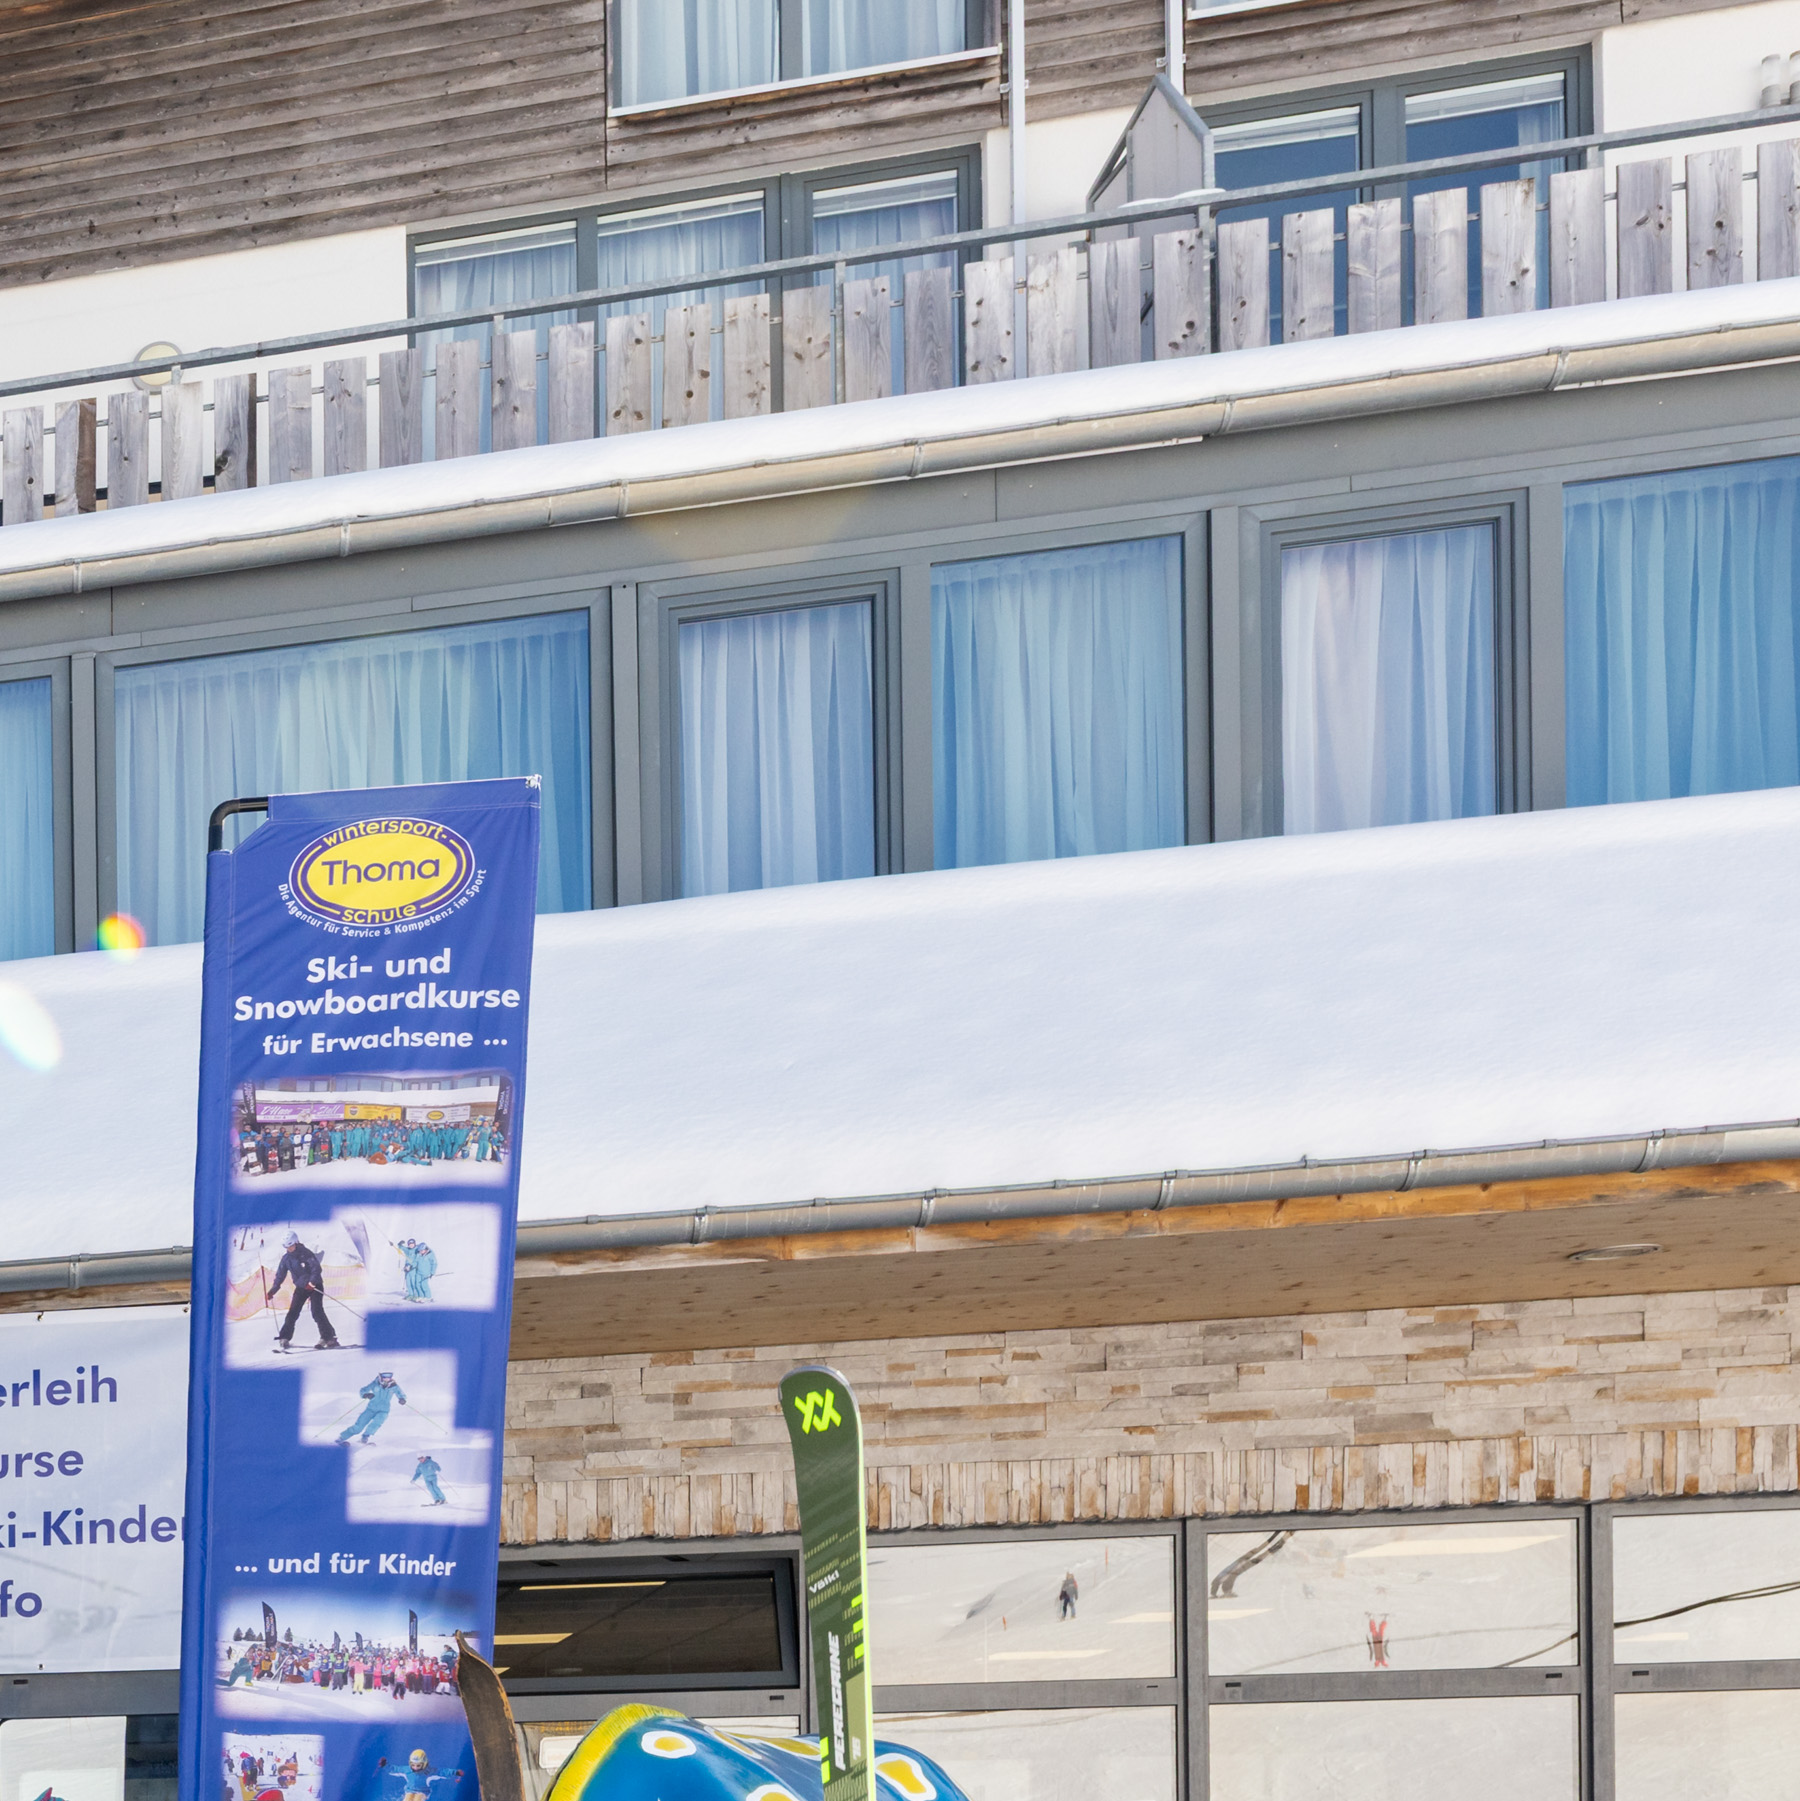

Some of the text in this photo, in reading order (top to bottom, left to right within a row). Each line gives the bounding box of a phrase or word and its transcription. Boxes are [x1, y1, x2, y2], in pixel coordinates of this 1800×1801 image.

[323, 820, 447, 847] wintersport-
[321, 858, 440, 886] Thoma
[278, 868, 487, 938] Die Agentur für Service & Kompetenz im Sport
[341, 903, 417, 924] schule
[306, 948, 450, 984] Ski- und
[233, 982, 520, 1021] Snowboardkurse
[262, 1034, 302, 1055] für
[310, 1026, 474, 1054] Erwachsene
[268, 1553, 320, 1574] und
[329, 1552, 369, 1575] für
[378, 1553, 456, 1577] Kinder
[809, 1569, 840, 1593] Völkl
[828, 1630, 846, 1771] PEREGRINE
